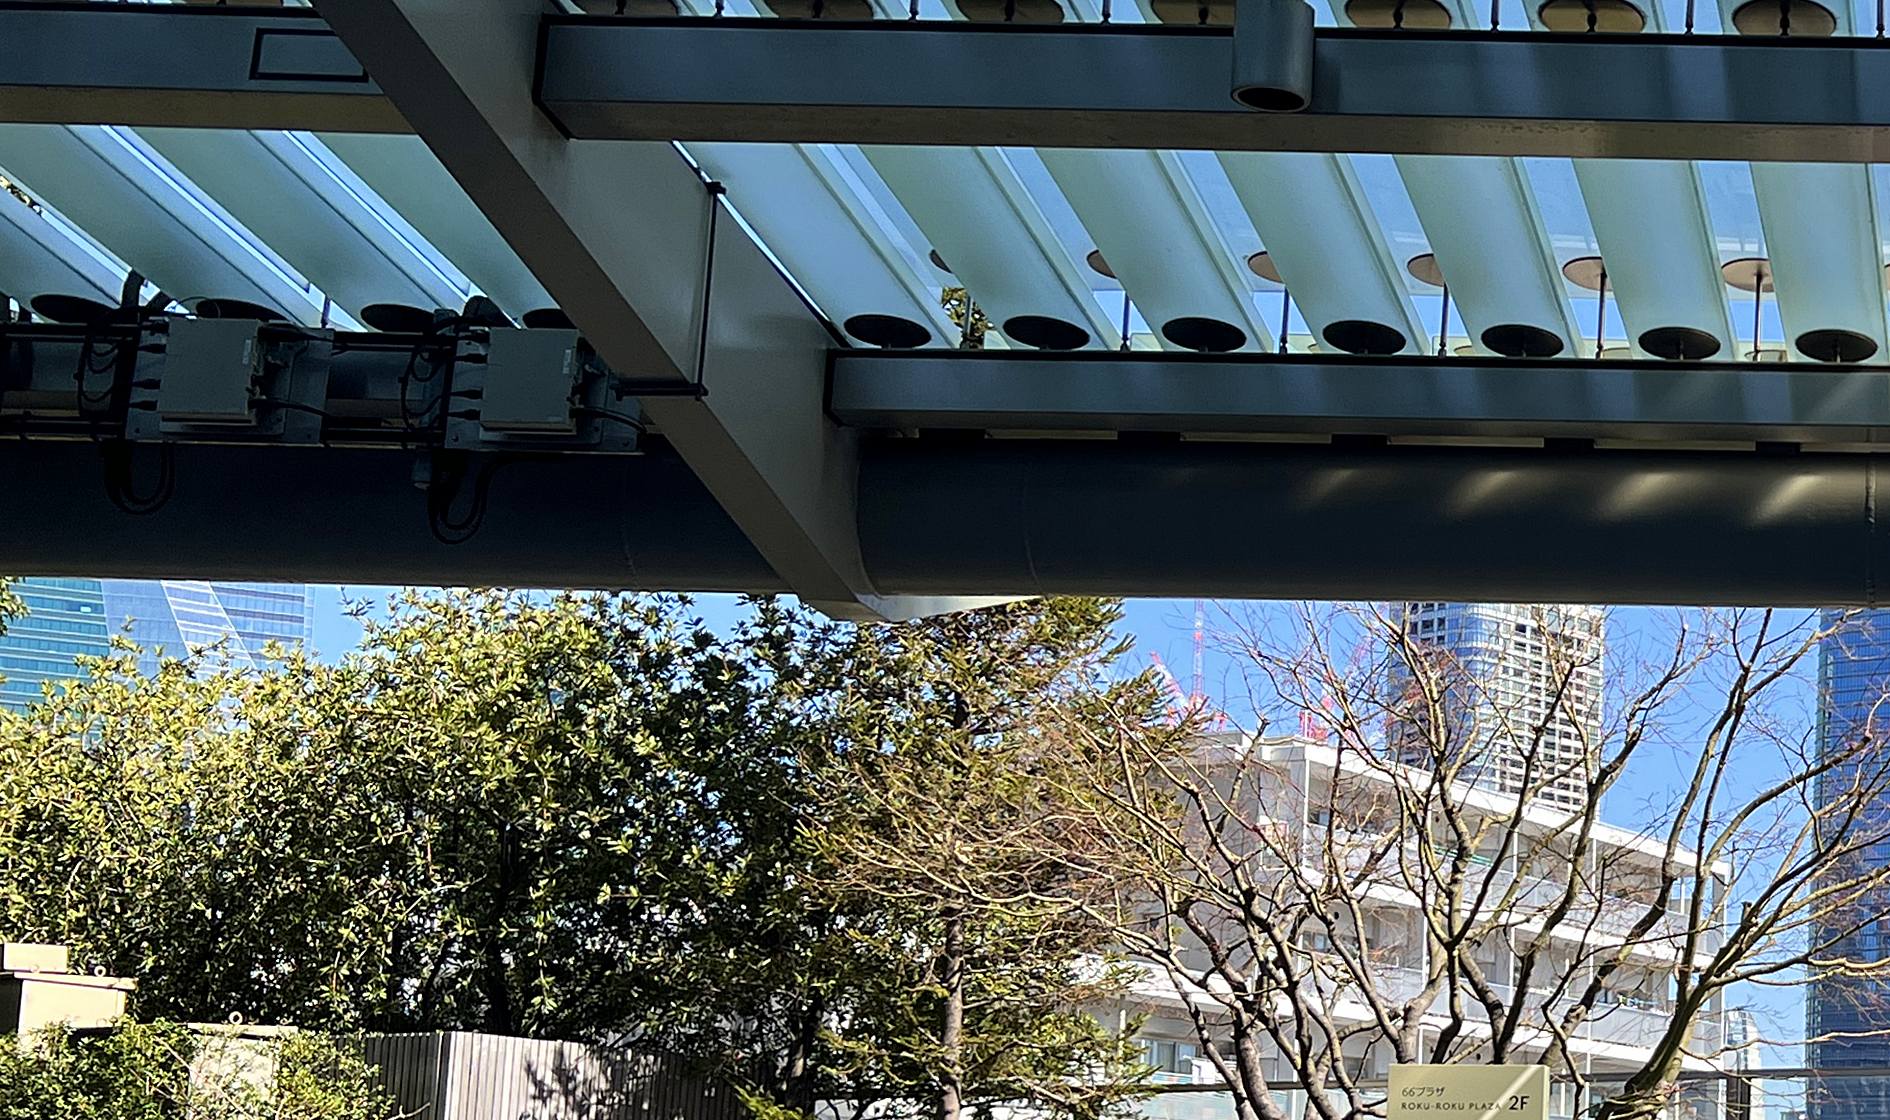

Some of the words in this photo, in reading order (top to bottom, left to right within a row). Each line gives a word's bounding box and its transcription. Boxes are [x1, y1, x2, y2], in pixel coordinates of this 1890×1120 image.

[1401, 1087, 1445, 1097] 66プラザ
[1401, 1102, 1465, 1111] ROKU-ROKU
[1469, 1102, 1501, 1111] PLAZA
[1508, 1095, 1530, 1111] 2F
